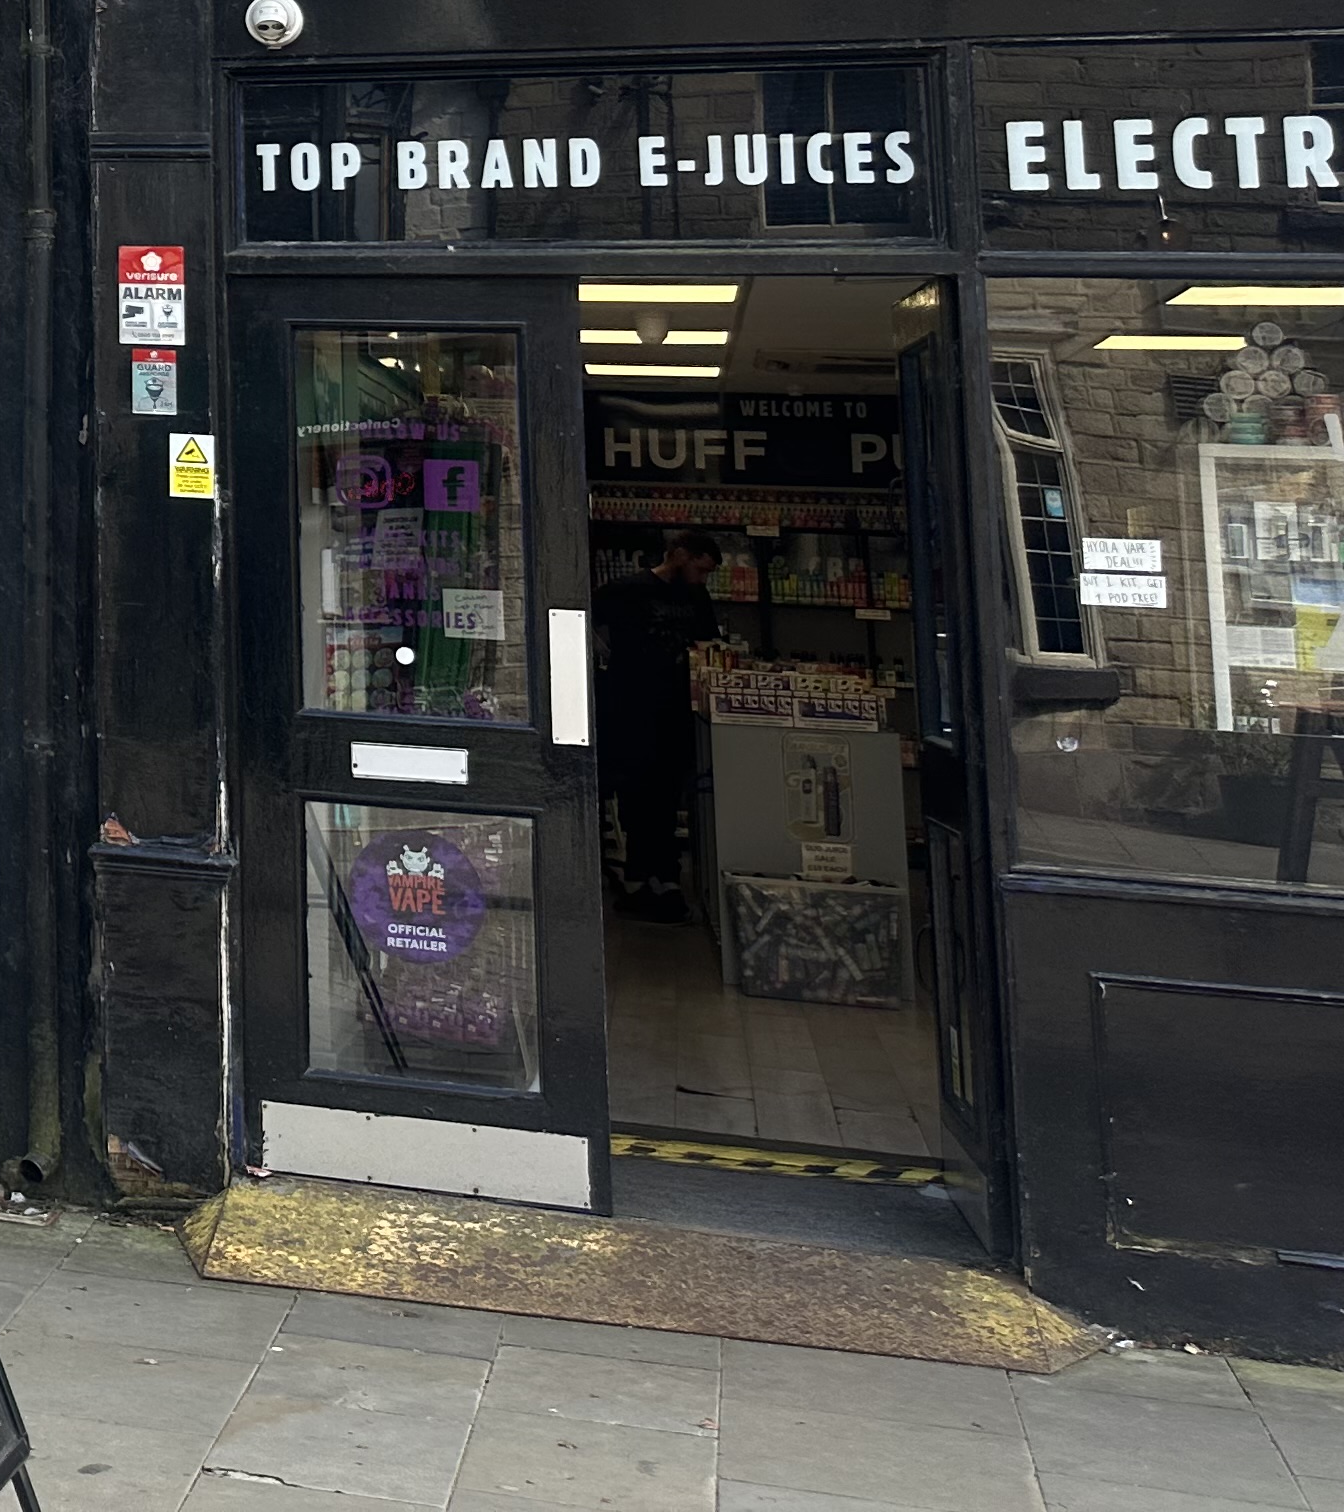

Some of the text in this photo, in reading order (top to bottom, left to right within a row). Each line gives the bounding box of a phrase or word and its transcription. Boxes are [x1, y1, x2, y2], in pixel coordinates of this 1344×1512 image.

[256, 131, 915, 192] TOP BRAND E-JUICES
[1005, 115, 1340, 191] ELECTR
[125, 271, 178, 282] verisure
[122, 287, 182, 301] ALARM
[739, 399, 868, 419] WELCOME TO
[603, 427, 768, 472] HUFF
[387, 875, 445, 892] VAMPIRE
[389, 887, 447, 916] VAPE
[387, 923, 446, 939] OFFICIAL
[387, 936, 447, 953] RETAILER
